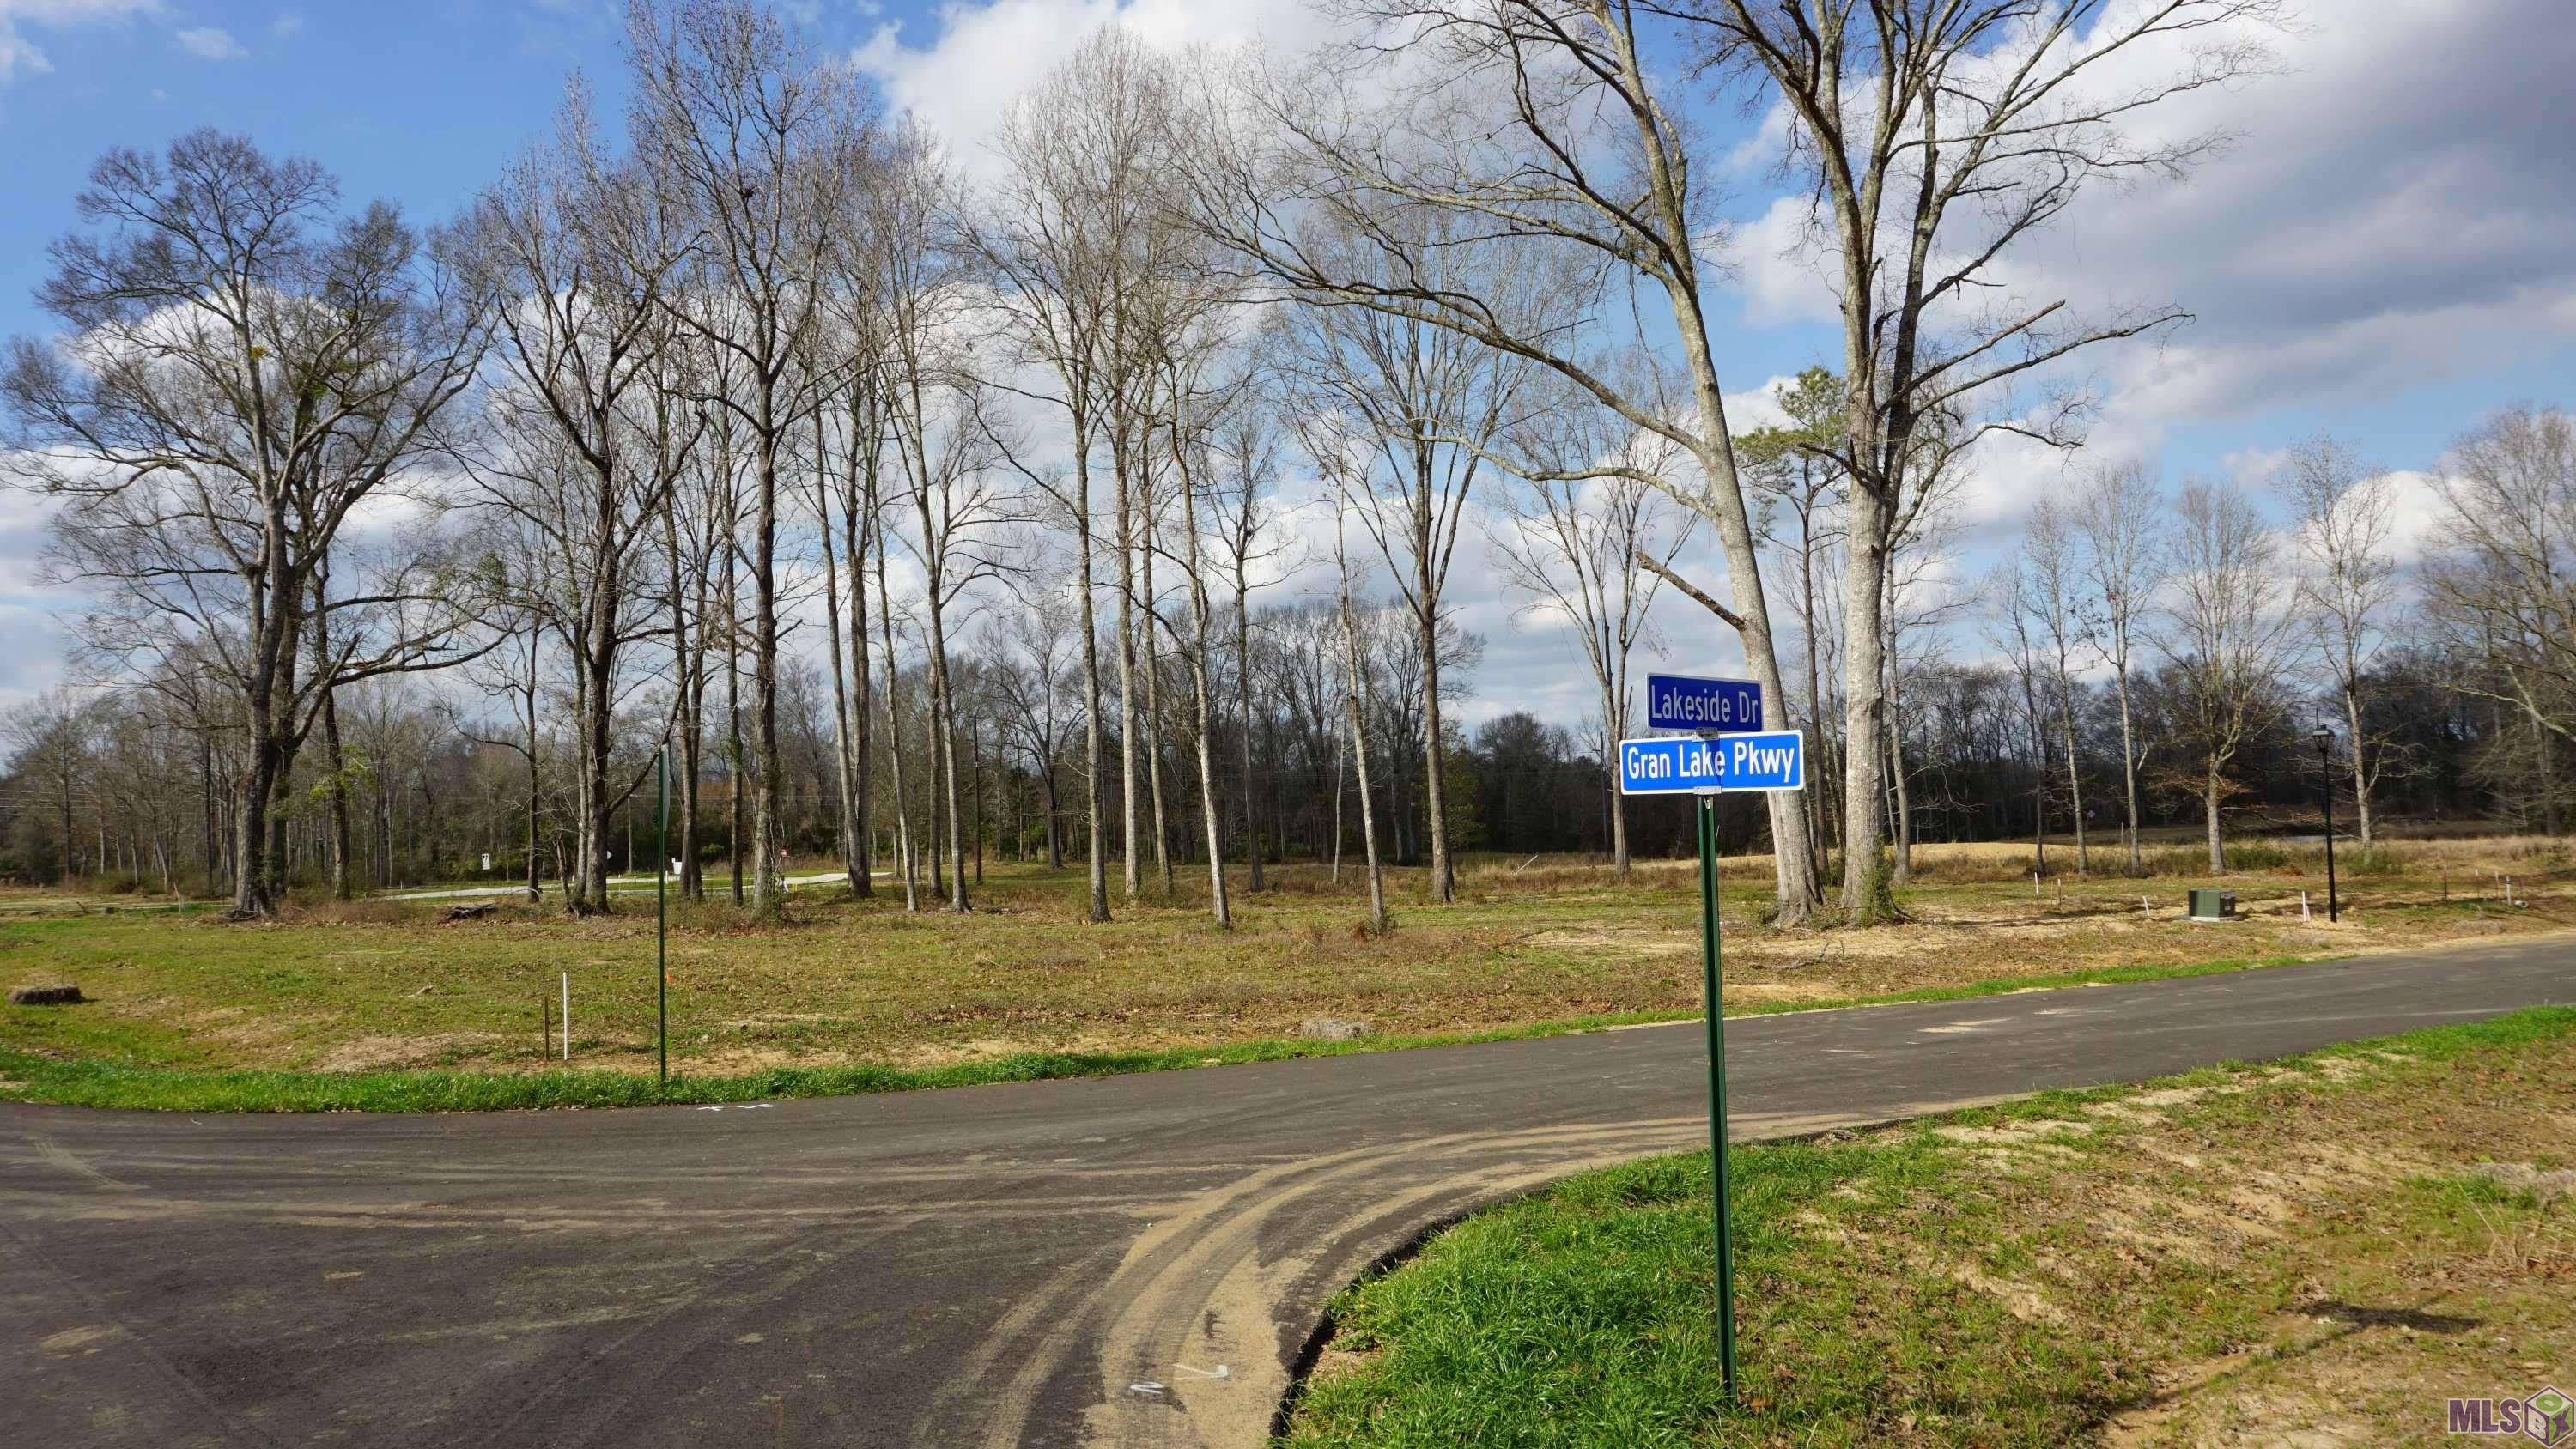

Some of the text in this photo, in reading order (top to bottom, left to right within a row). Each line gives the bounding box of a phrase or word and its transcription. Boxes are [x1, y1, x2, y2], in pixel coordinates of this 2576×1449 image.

[1651, 685, 1759, 724] Lakeside Dr
[1628, 741, 1795, 783] Gran Lake Pkwy
